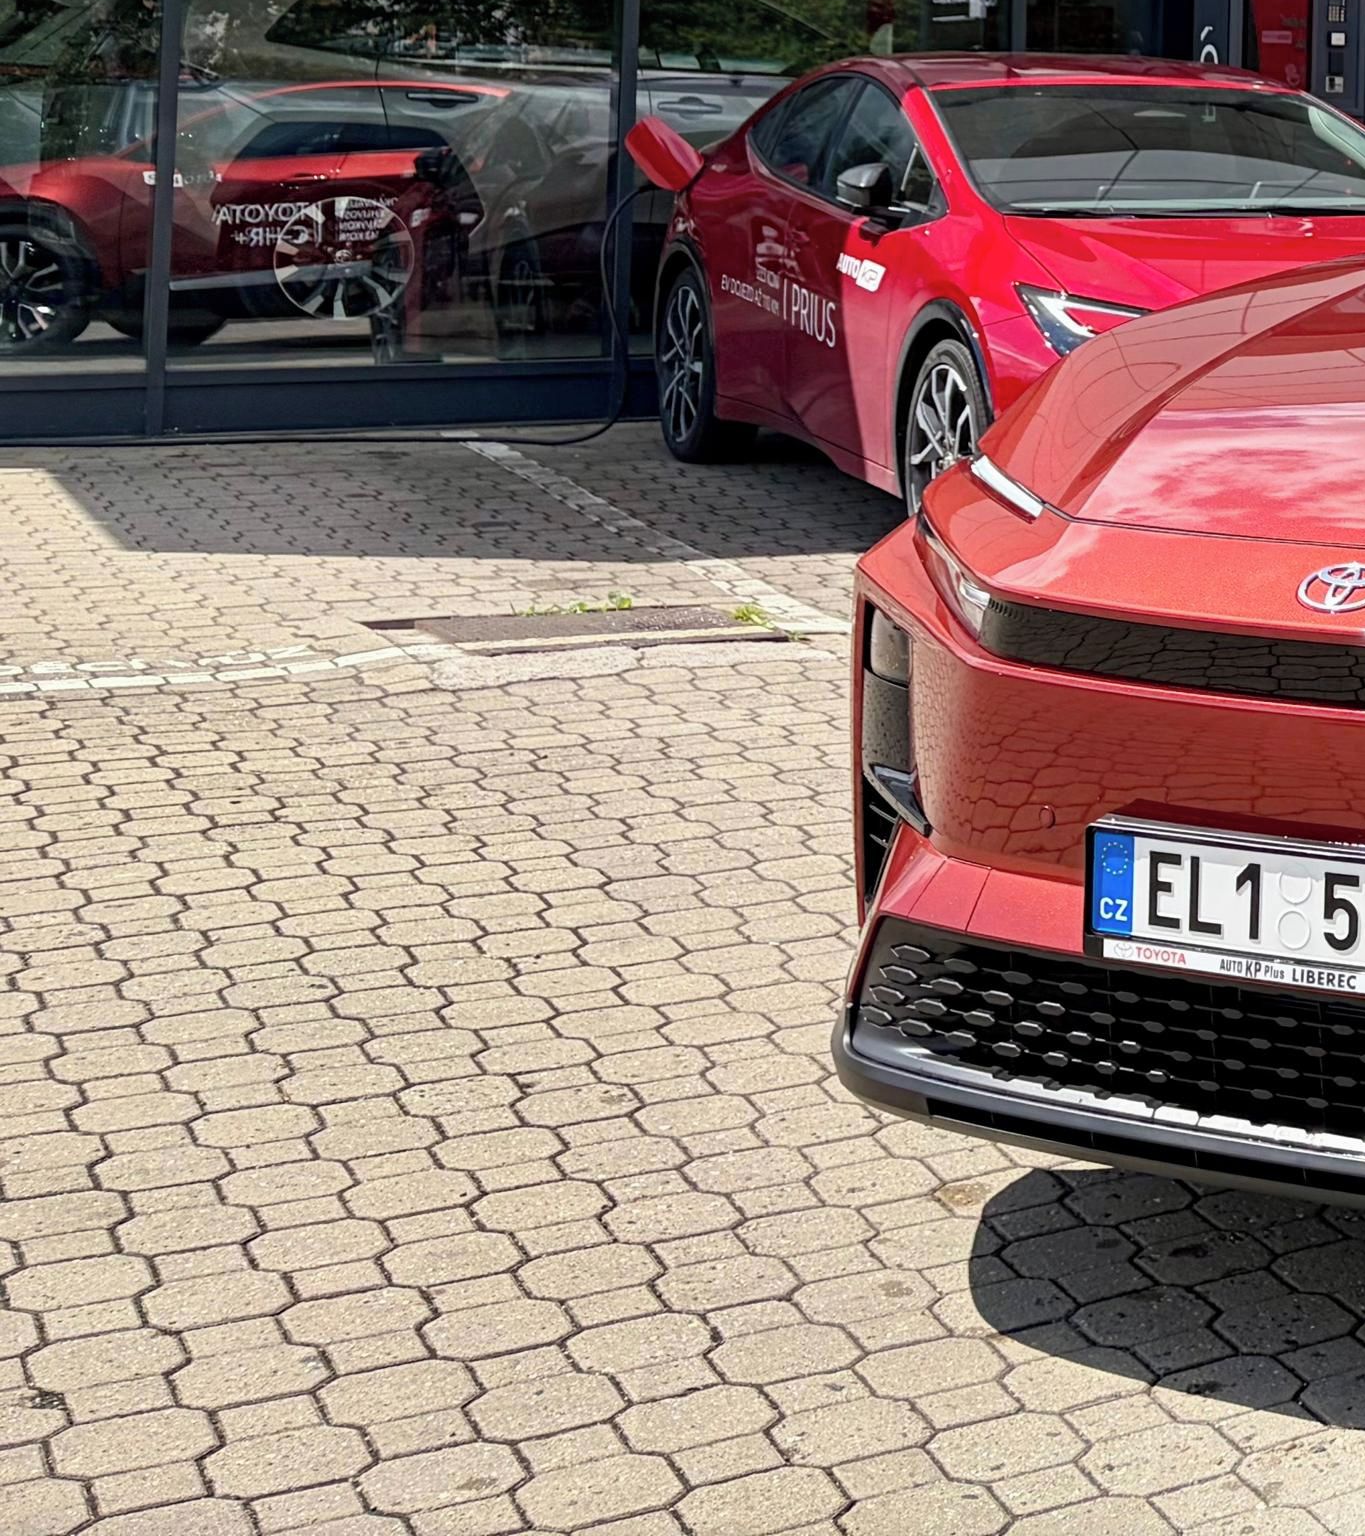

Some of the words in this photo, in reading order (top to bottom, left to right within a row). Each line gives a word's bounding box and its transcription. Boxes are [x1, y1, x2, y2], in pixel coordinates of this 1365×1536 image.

[835, 252, 862, 280] AUTO
[791, 284, 836, 348] PRIUS
[1099, 894, 1128, 922] CZ
[1147, 849, 1262, 942] EL1
[1135, 945, 1187, 966] TOYOTA
[1219, 958, 1244, 976] AUTO
[1244, 959, 1262, 979] KP
[1263, 964, 1286, 980] Plus
[1291, 967, 1358, 991] LIBEREC
